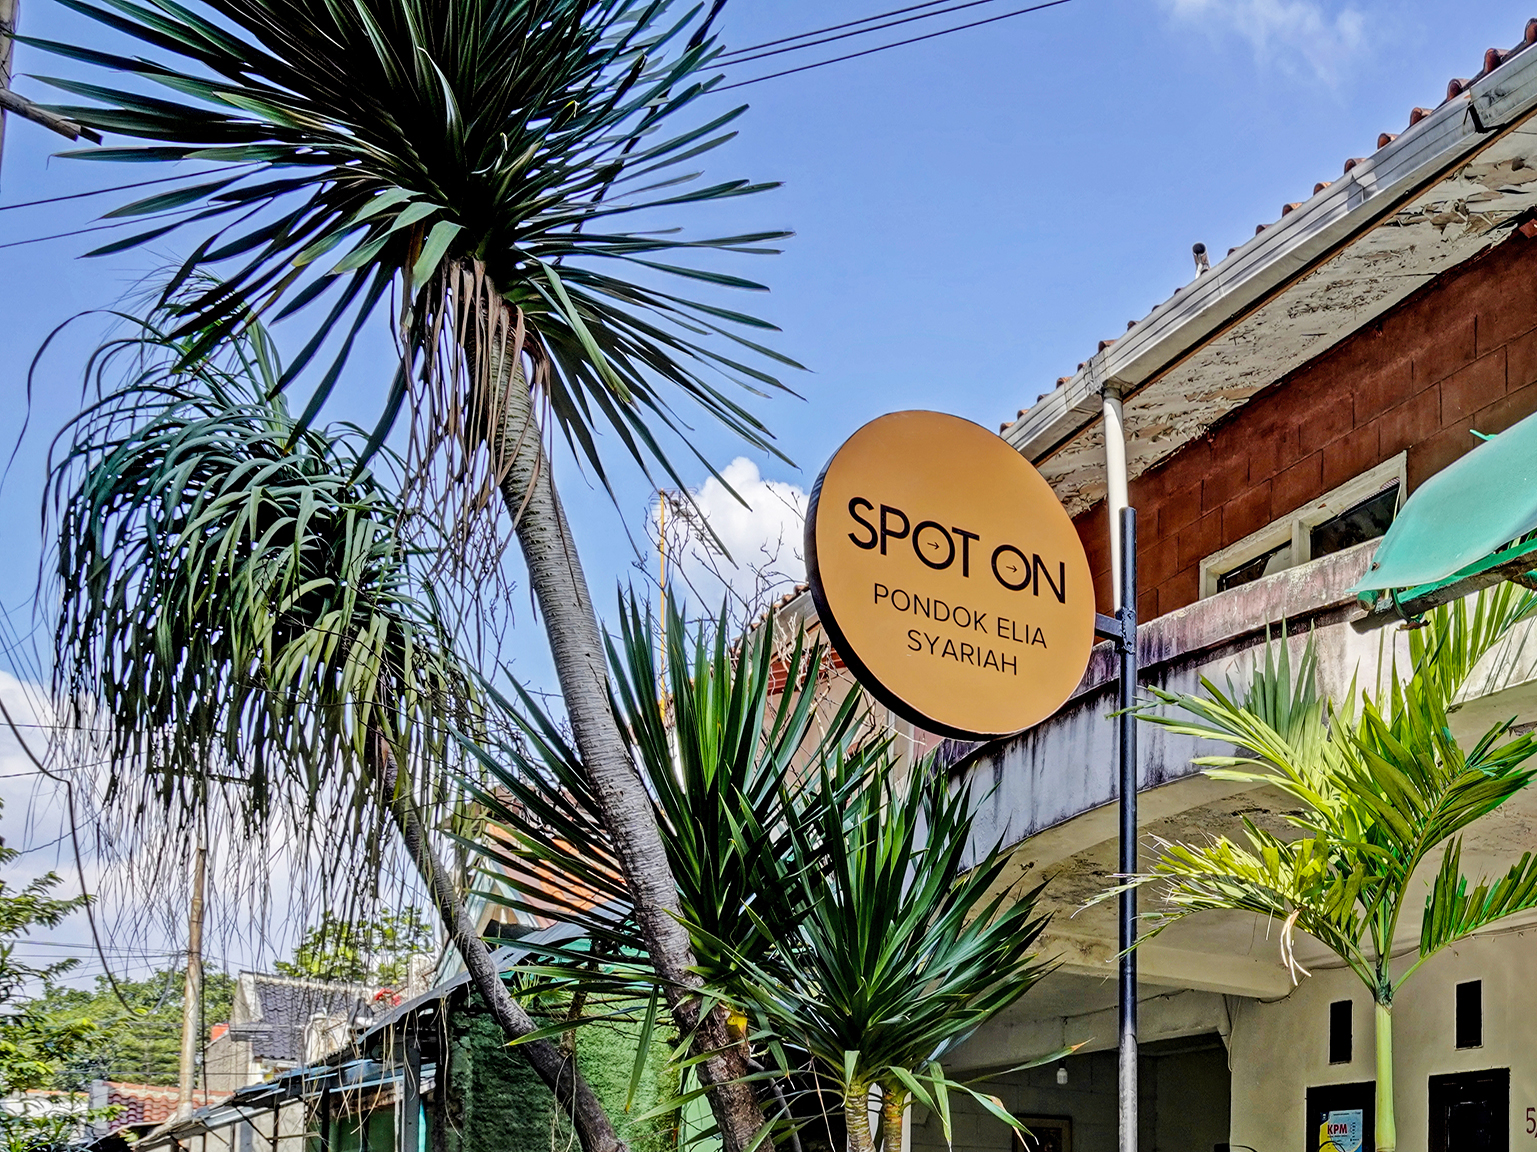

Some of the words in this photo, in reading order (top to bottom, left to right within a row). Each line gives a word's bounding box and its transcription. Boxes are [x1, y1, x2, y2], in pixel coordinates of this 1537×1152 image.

[847, 496, 980, 578] SPOT
[990, 544, 1066, 604] ON
[873, 583, 988, 634] PONDOK
[997, 616, 1047, 649] ELIA
[907, 629, 1018, 676] SYARIAH
[1327, 1123, 1348, 1134] KPM
